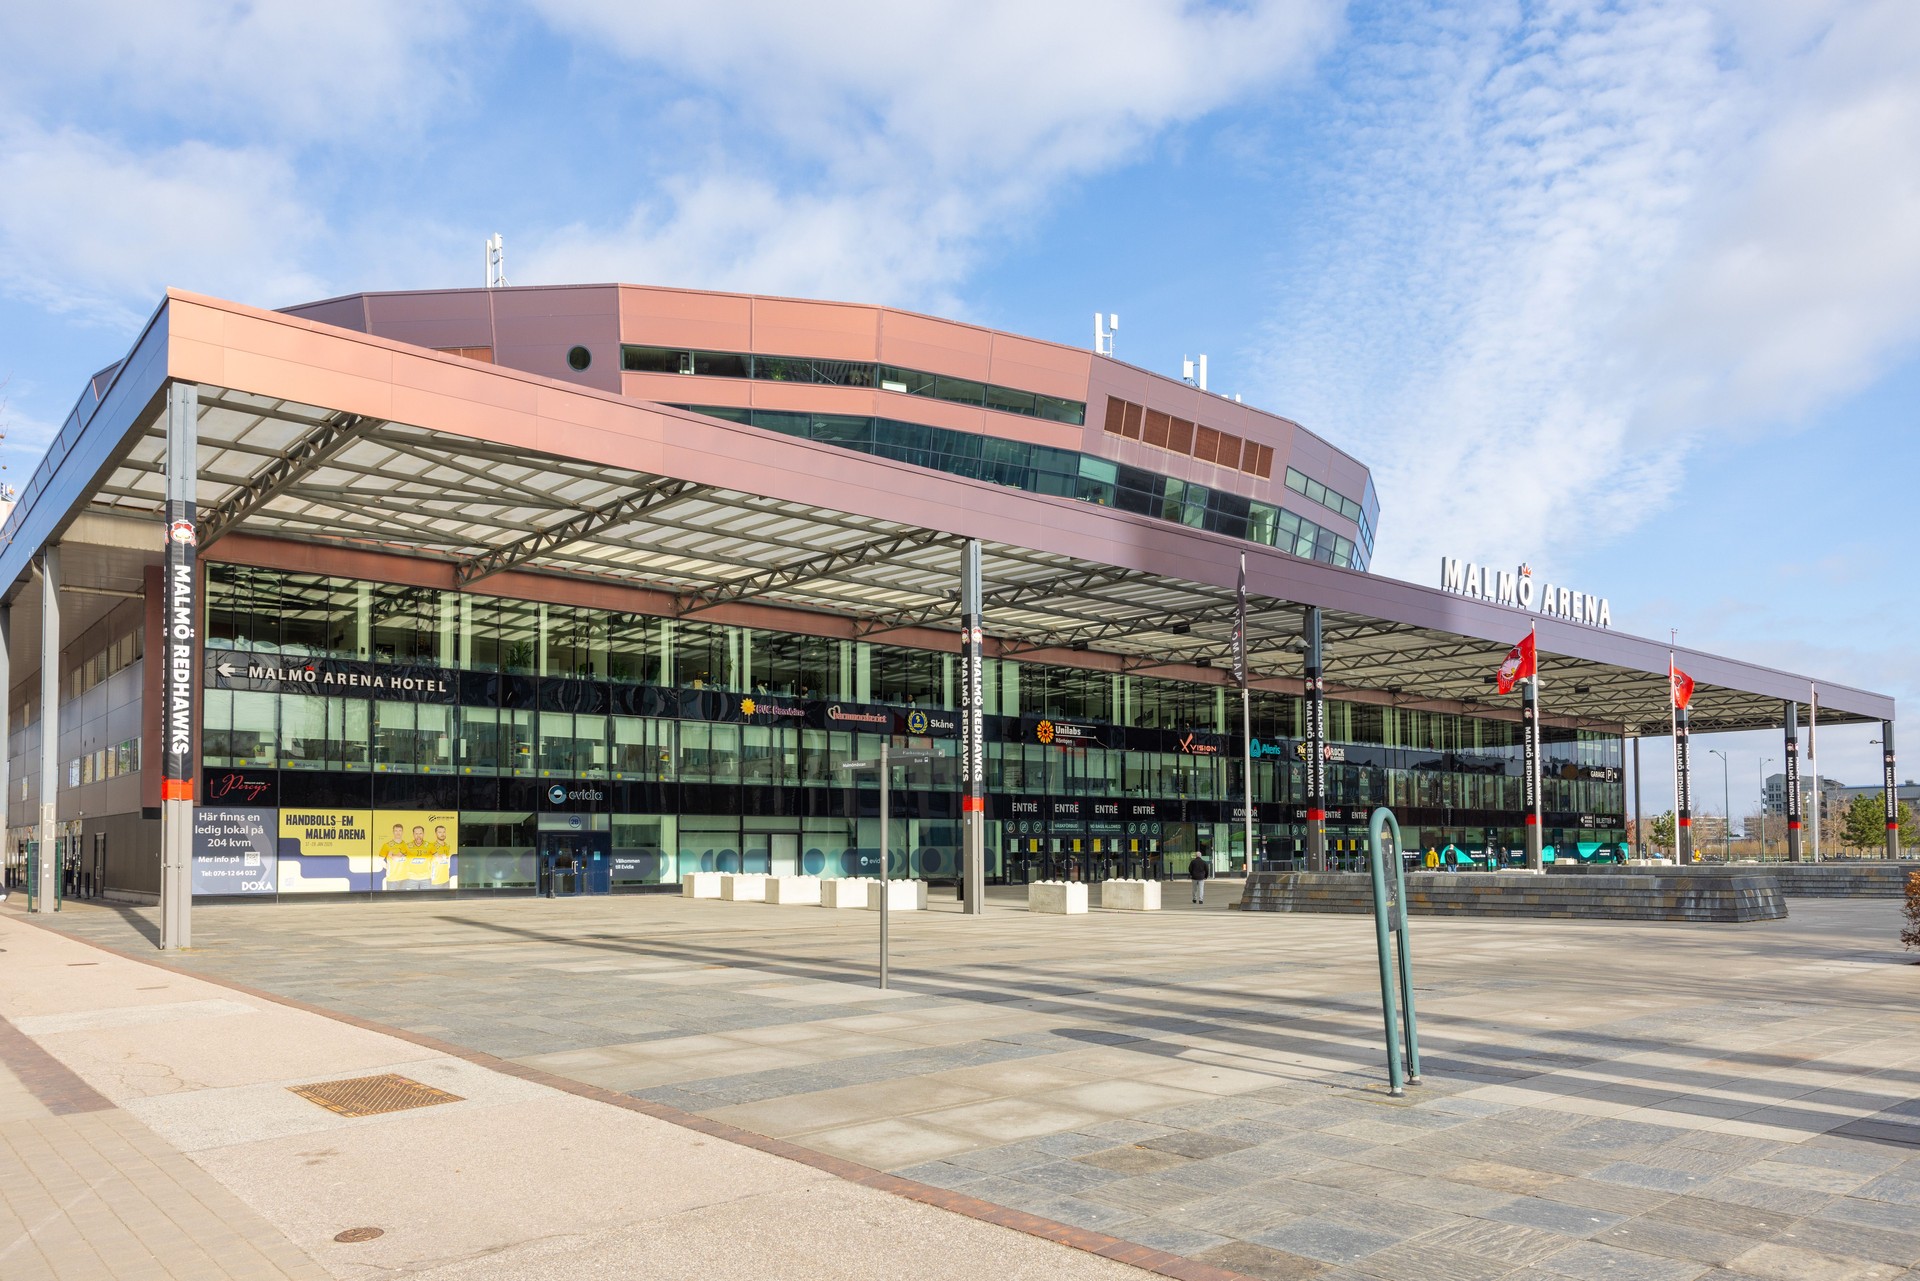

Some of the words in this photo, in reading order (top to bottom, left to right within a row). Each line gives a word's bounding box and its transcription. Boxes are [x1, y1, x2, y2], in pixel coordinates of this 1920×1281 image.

[1441, 556, 1534, 607] MALMÖ
[1540, 584, 1612, 626] ARENA
[174, 565, 194, 638] MALMÖ
[248, 666, 316, 682] MALMÖ
[324, 672, 384, 688] ARENA
[390, 678, 446, 692] HOTEL
[962, 657, 970, 706] MALMÖ
[973, 656, 983, 706] MALMÖ
[171, 645, 190, 754] REDHAWKS
[930, 719, 954, 729] Skåne
[1306, 700, 1315, 739] MALMÖ
[1056, 726, 1081, 735] Unilabs
[974, 709, 983, 782] REDHAWKS
[1525, 726, 1533, 758] MALMÖ
[1262, 744, 1280, 754] Aleris
[1676, 744, 1684, 770] MALMÖ
[569, 790, 602, 800] evidia
[199, 812, 218, 821] Här
[220, 812, 245, 821] finns
[1234, 808, 1258, 817] KONOR
[195, 825, 221, 836] ledig
[224, 825, 249, 834] lokal
[251, 825, 264, 836] på
[306, 827, 336, 839] MALMÖ
[338, 829, 366, 840] ARENA
[208, 839, 227, 847] 204
[229, 838, 252, 847] kvm
[230, 856, 239, 864] på
[242, 881, 273, 890] DOXA
